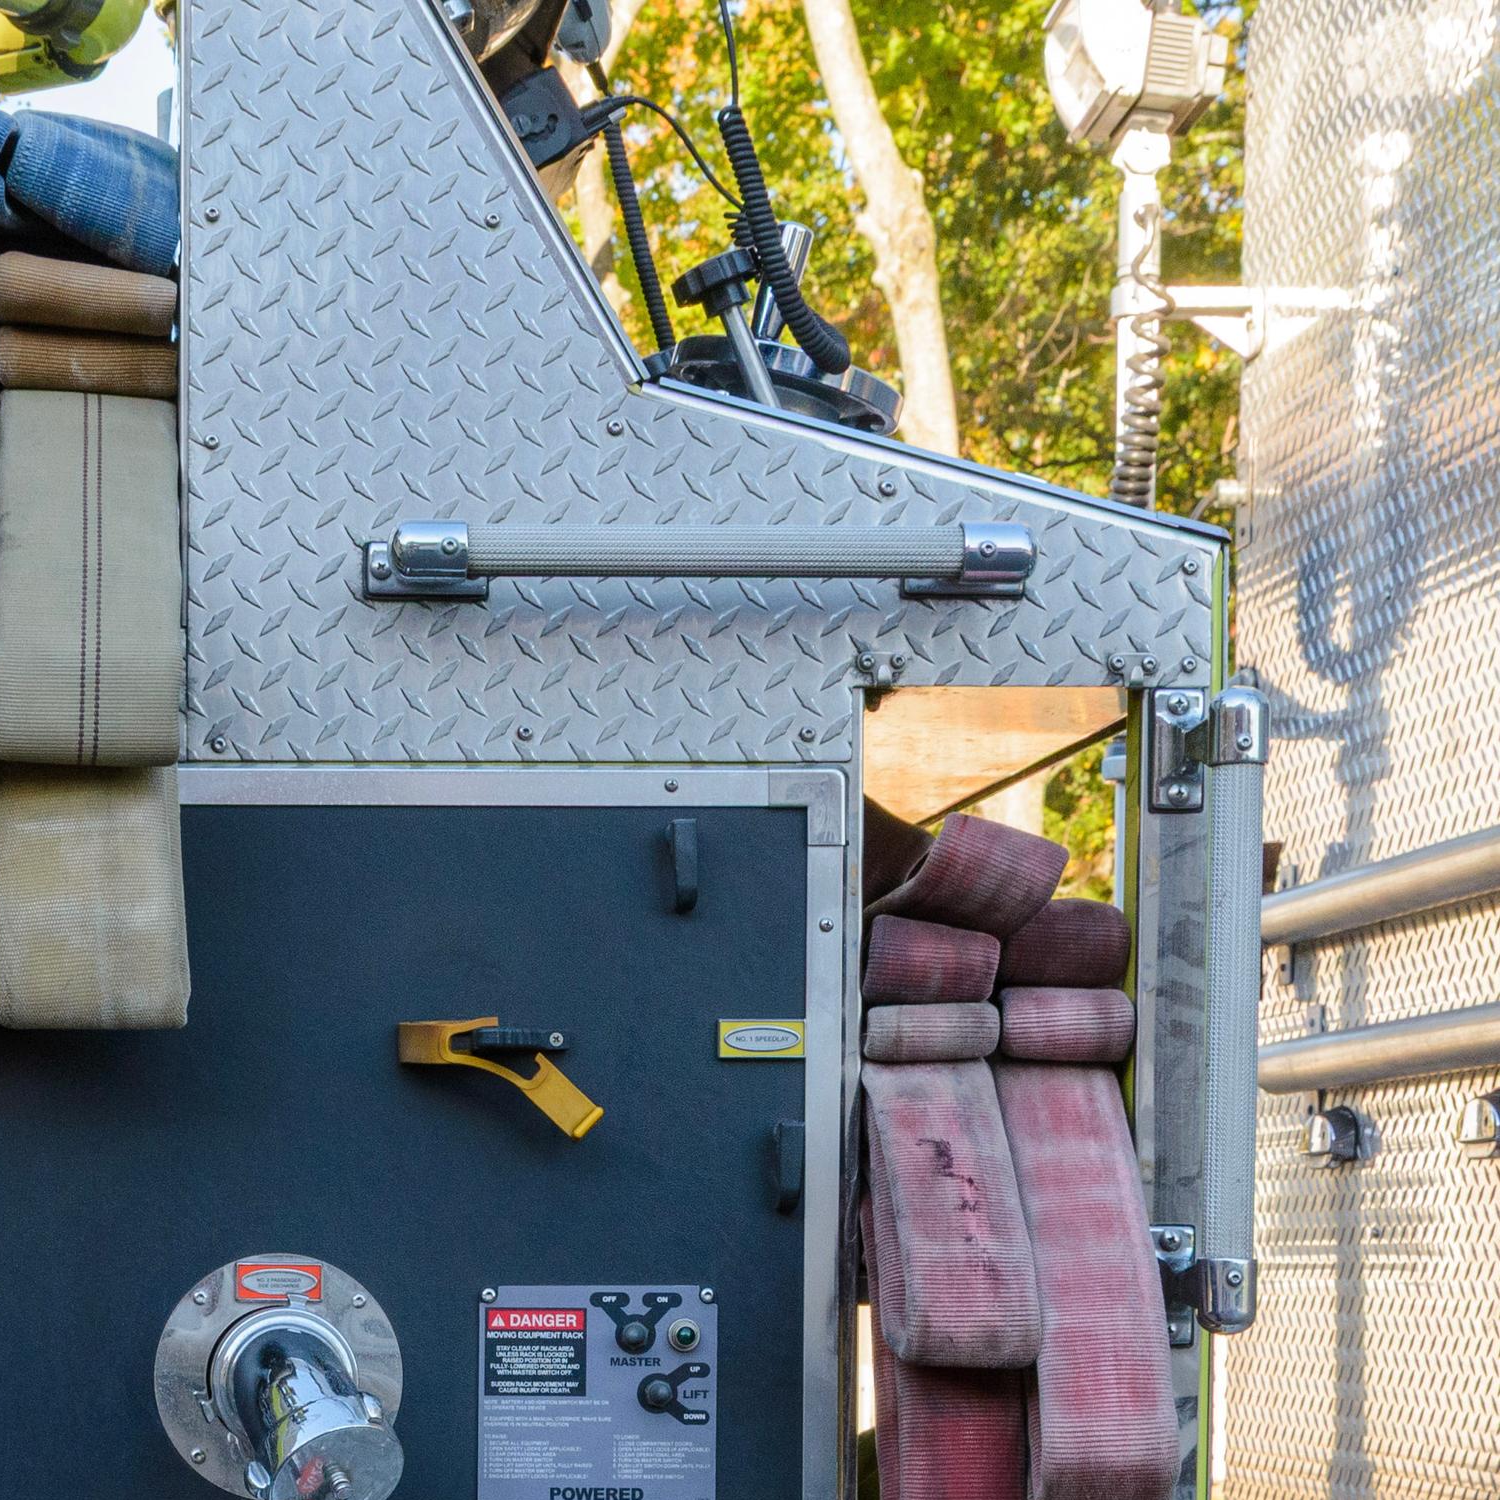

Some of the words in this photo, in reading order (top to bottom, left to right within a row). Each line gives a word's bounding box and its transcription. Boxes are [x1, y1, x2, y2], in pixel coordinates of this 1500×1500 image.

[509, 1314, 577, 1327] DANGER
[486, 1331, 517, 1339] MOVING
[518, 1331, 561, 1339] EQUIPMENT
[561, 1331, 584, 1339] RACK
[610, 1357, 661, 1367] MASTER
[682, 1390, 709, 1400] LIFT
[683, 1413, 706, 1421] DOWN
[550, 1487, 644, 1500] POWERED
